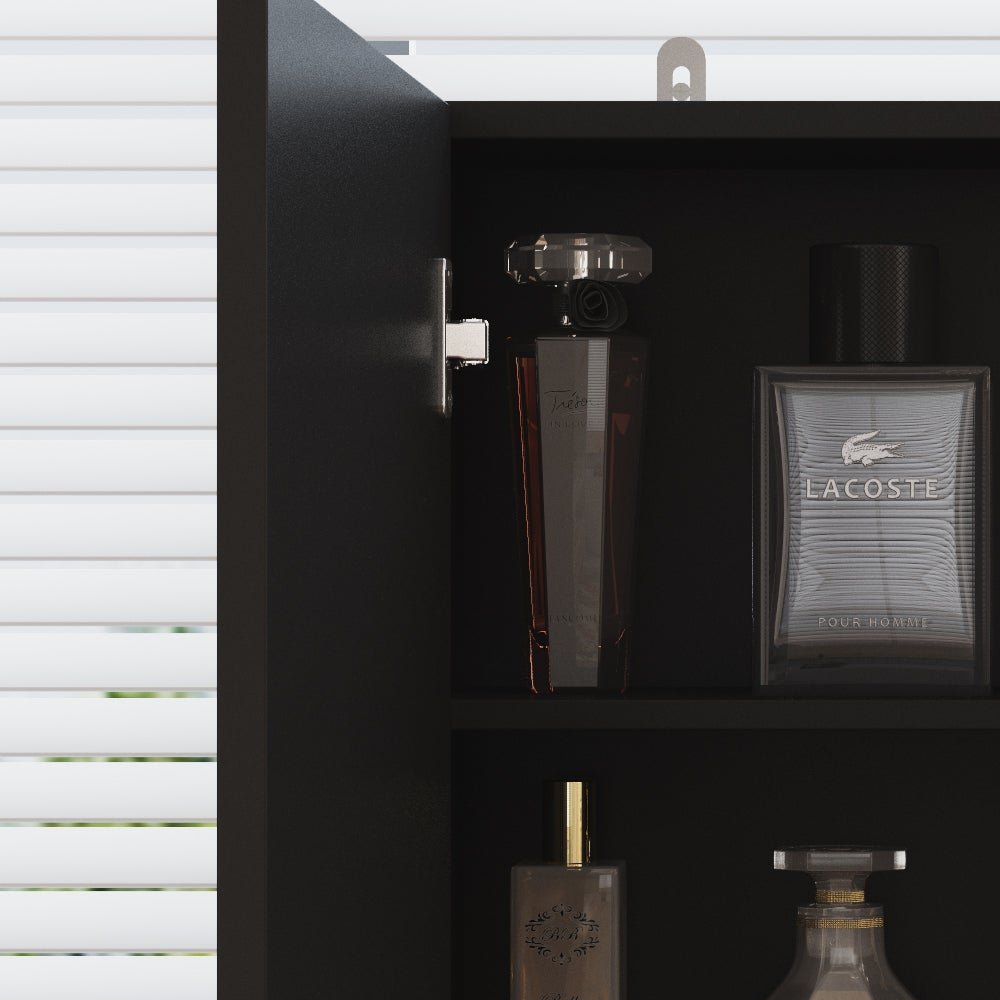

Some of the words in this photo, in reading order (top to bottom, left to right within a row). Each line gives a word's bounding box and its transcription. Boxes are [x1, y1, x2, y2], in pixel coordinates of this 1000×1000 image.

[806, 478, 938, 499] LACOSTE
[818, 617, 861, 628] POUR
[869, 617, 928, 629] HOMME
